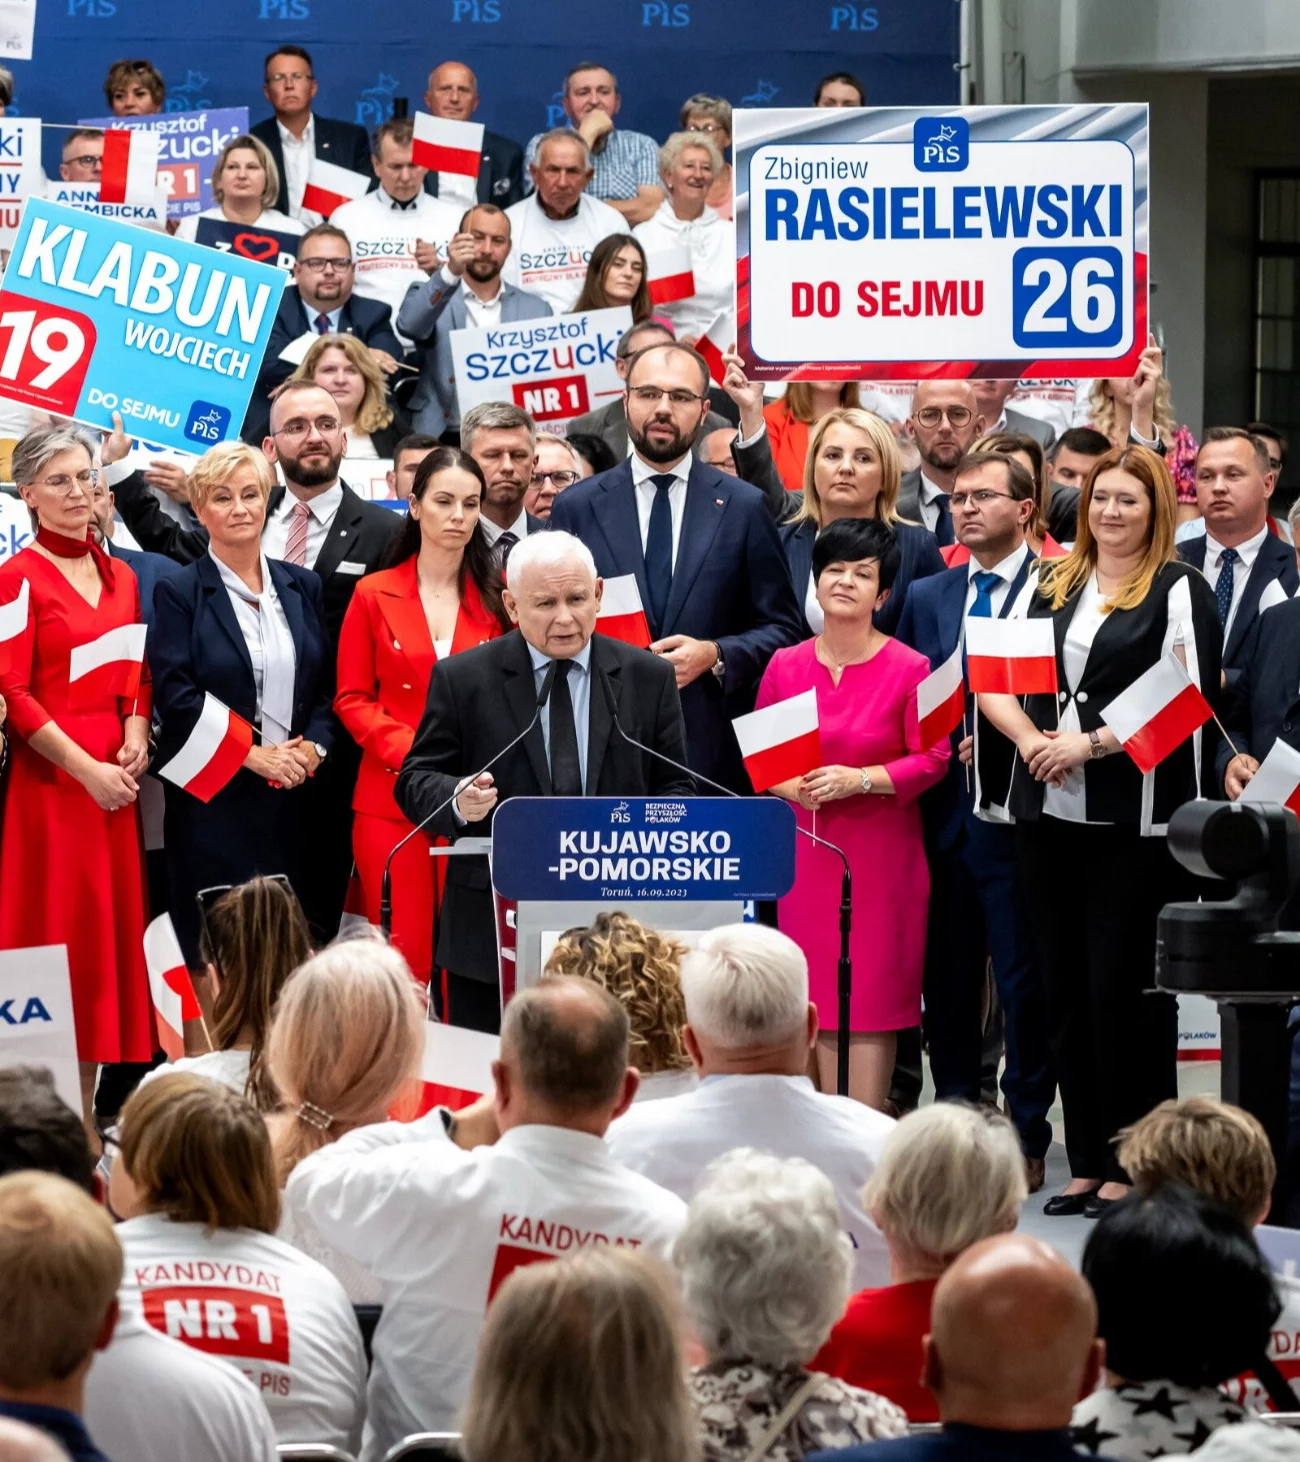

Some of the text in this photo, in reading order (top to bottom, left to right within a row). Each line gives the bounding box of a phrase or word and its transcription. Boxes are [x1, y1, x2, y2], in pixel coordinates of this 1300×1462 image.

[452, 0, 502, 23] PiS
[642, 3, 691, 28] PiS
[831, 6, 880, 31] PiS
[924, 146, 960, 164] PiS
[764, 156, 868, 186] Zbigniew
[57, 190, 100, 202] ANN
[765, 184, 1122, 241] RASIELEWSKI
[17, 217, 272, 345] KLABUN
[1022, 257, 1116, 334] 26
[792, 280, 984, 318] DO SEJMU
[487, 317, 588, 350] Krzysztof
[0, 310, 86, 391] 19
[124, 318, 251, 380] WOJCIECH
[466, 330, 624, 382] Szczuck
[87, 388, 119, 410] DO
[120, 397, 181, 428] SEJMU
[523, 384, 580, 414] NR 1
[191, 421, 220, 440] PiS
[610, 812, 631, 824] PiS
[560, 830, 732, 855] KUJAWSKO
[548, 857, 741, 881] -POMORSKIE
[600, 886, 688, 898] Toruń, 16.09.2023
[135, 1262, 281, 1293] KANDYDAT
[163, 1299, 273, 1345] NR 1
